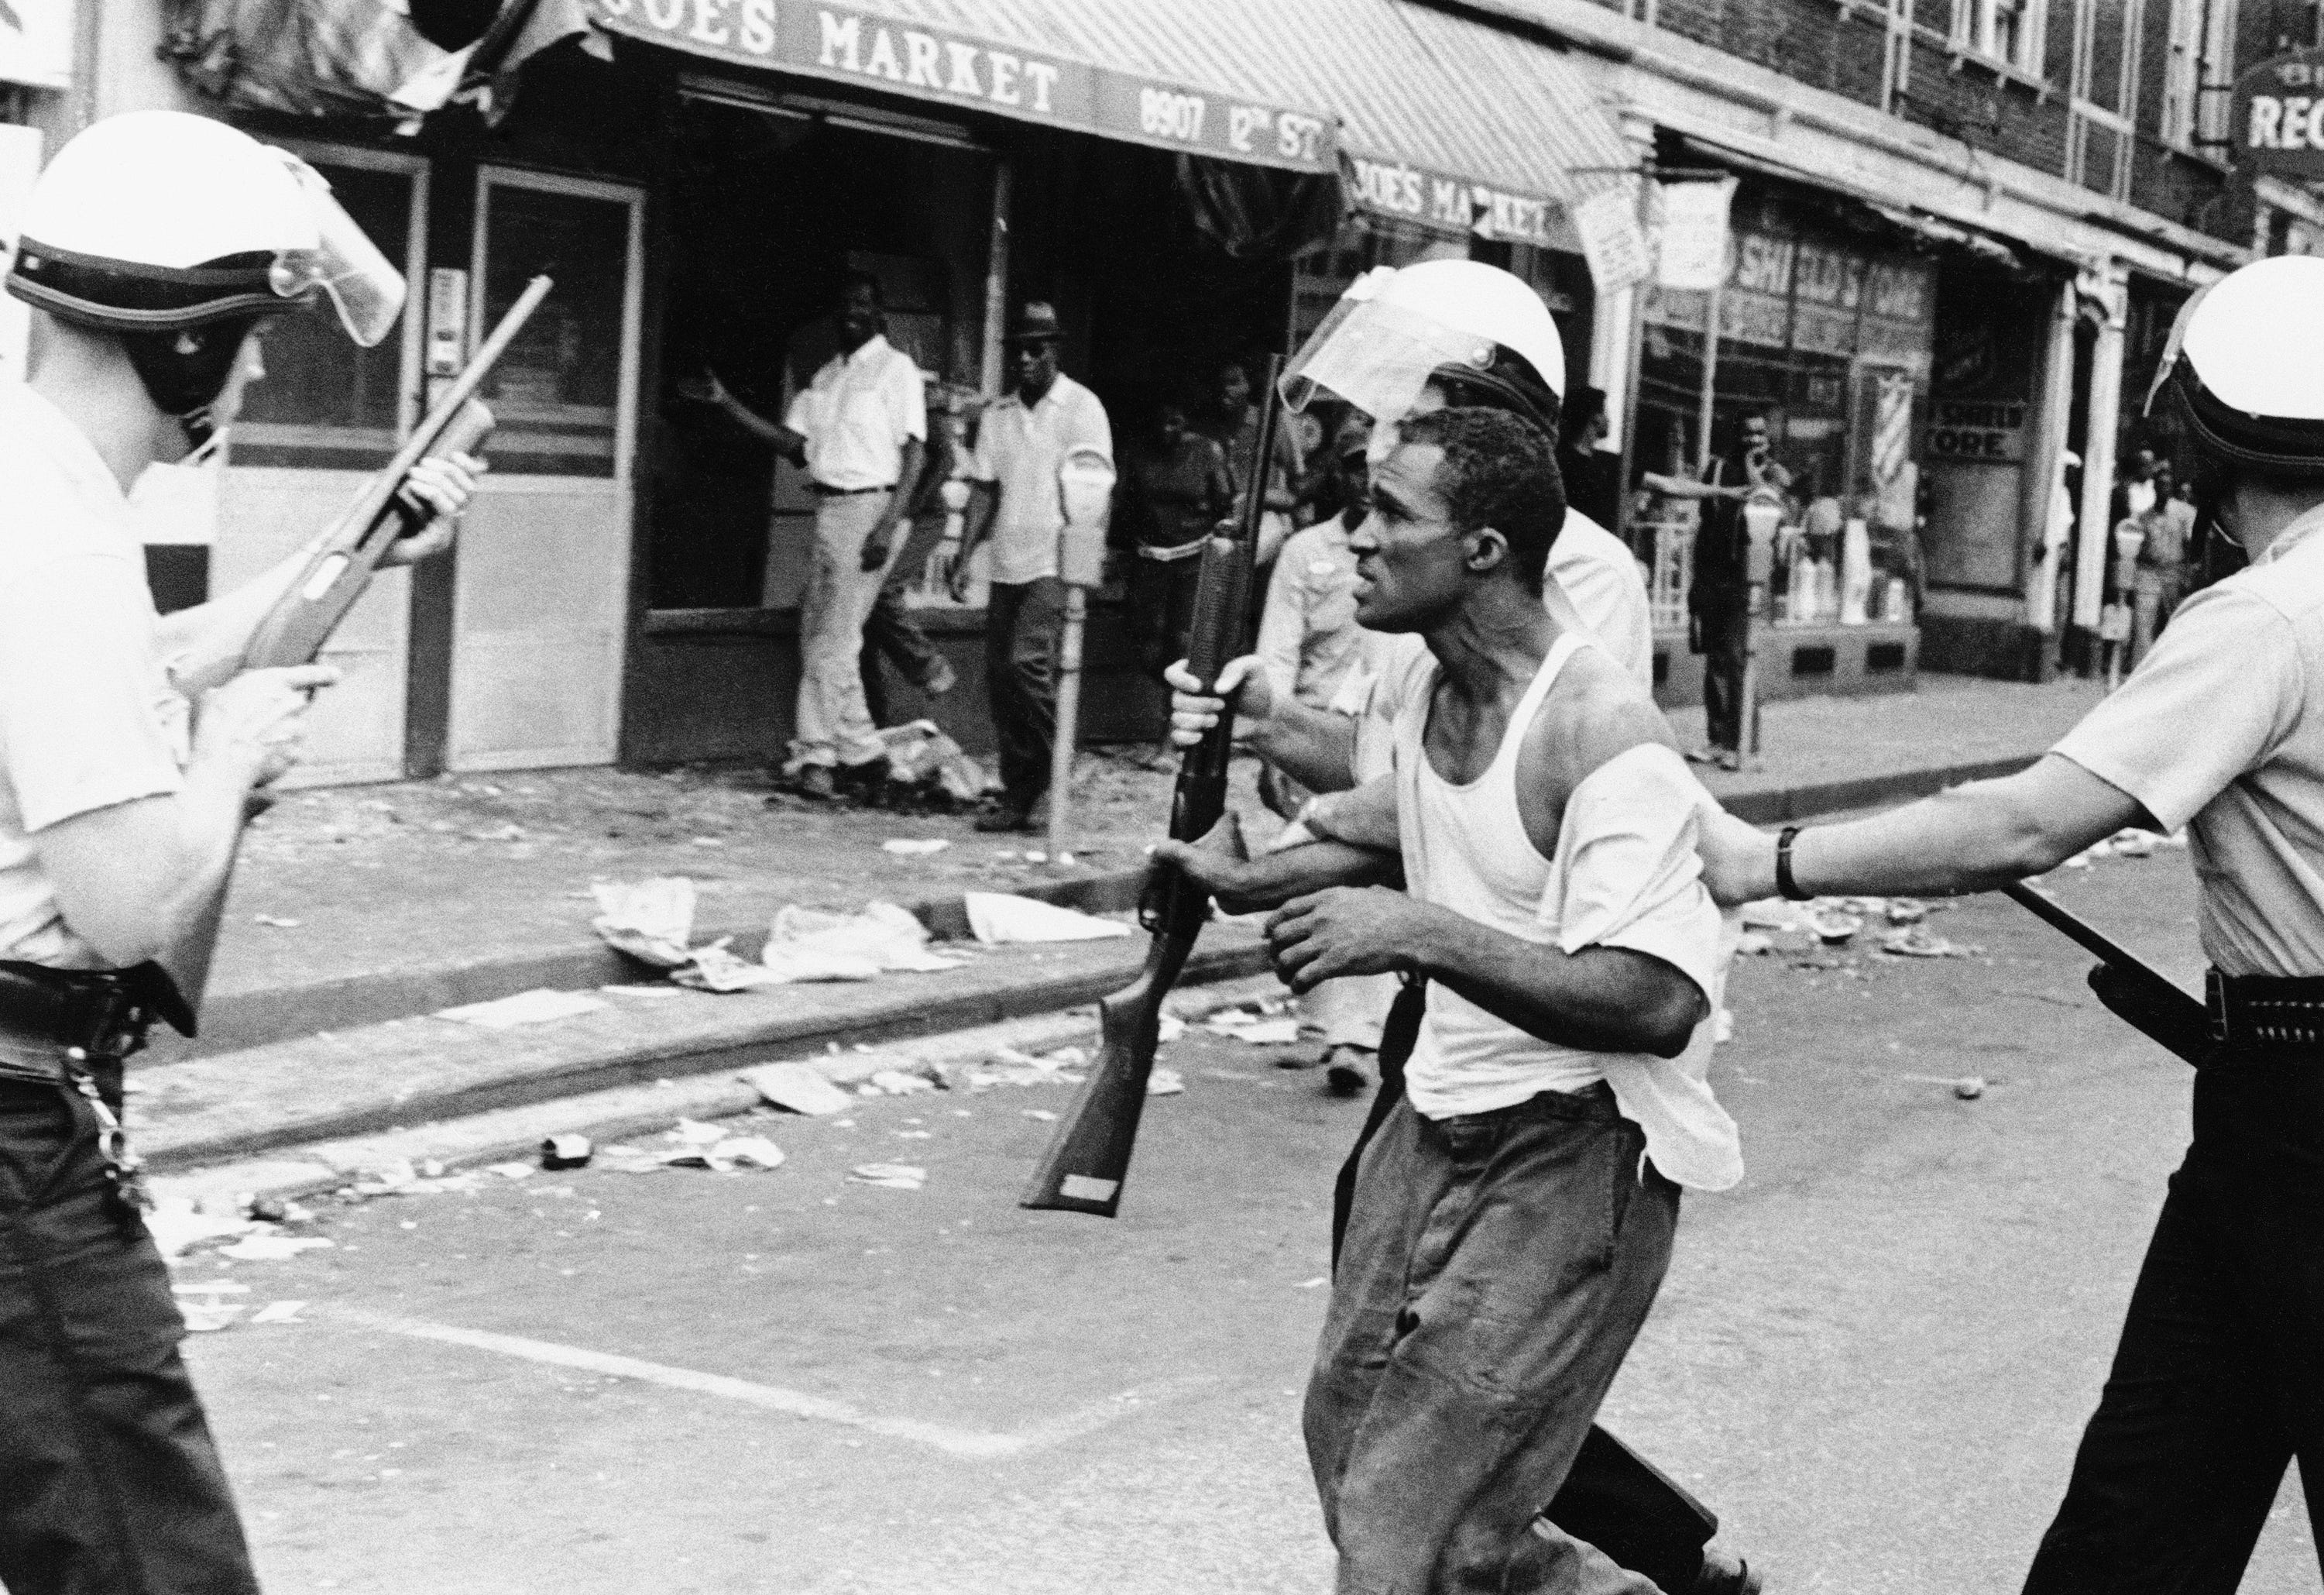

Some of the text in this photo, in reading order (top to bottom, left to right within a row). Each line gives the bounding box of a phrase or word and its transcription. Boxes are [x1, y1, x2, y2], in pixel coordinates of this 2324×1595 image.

[602, 0, 775, 53] OES
[819, 11, 1058, 111] MARKET
[1140, 88, 1205, 141] 8907
[1279, 113, 1322, 160] ST
[1352, 159, 1423, 214] JOE'S
